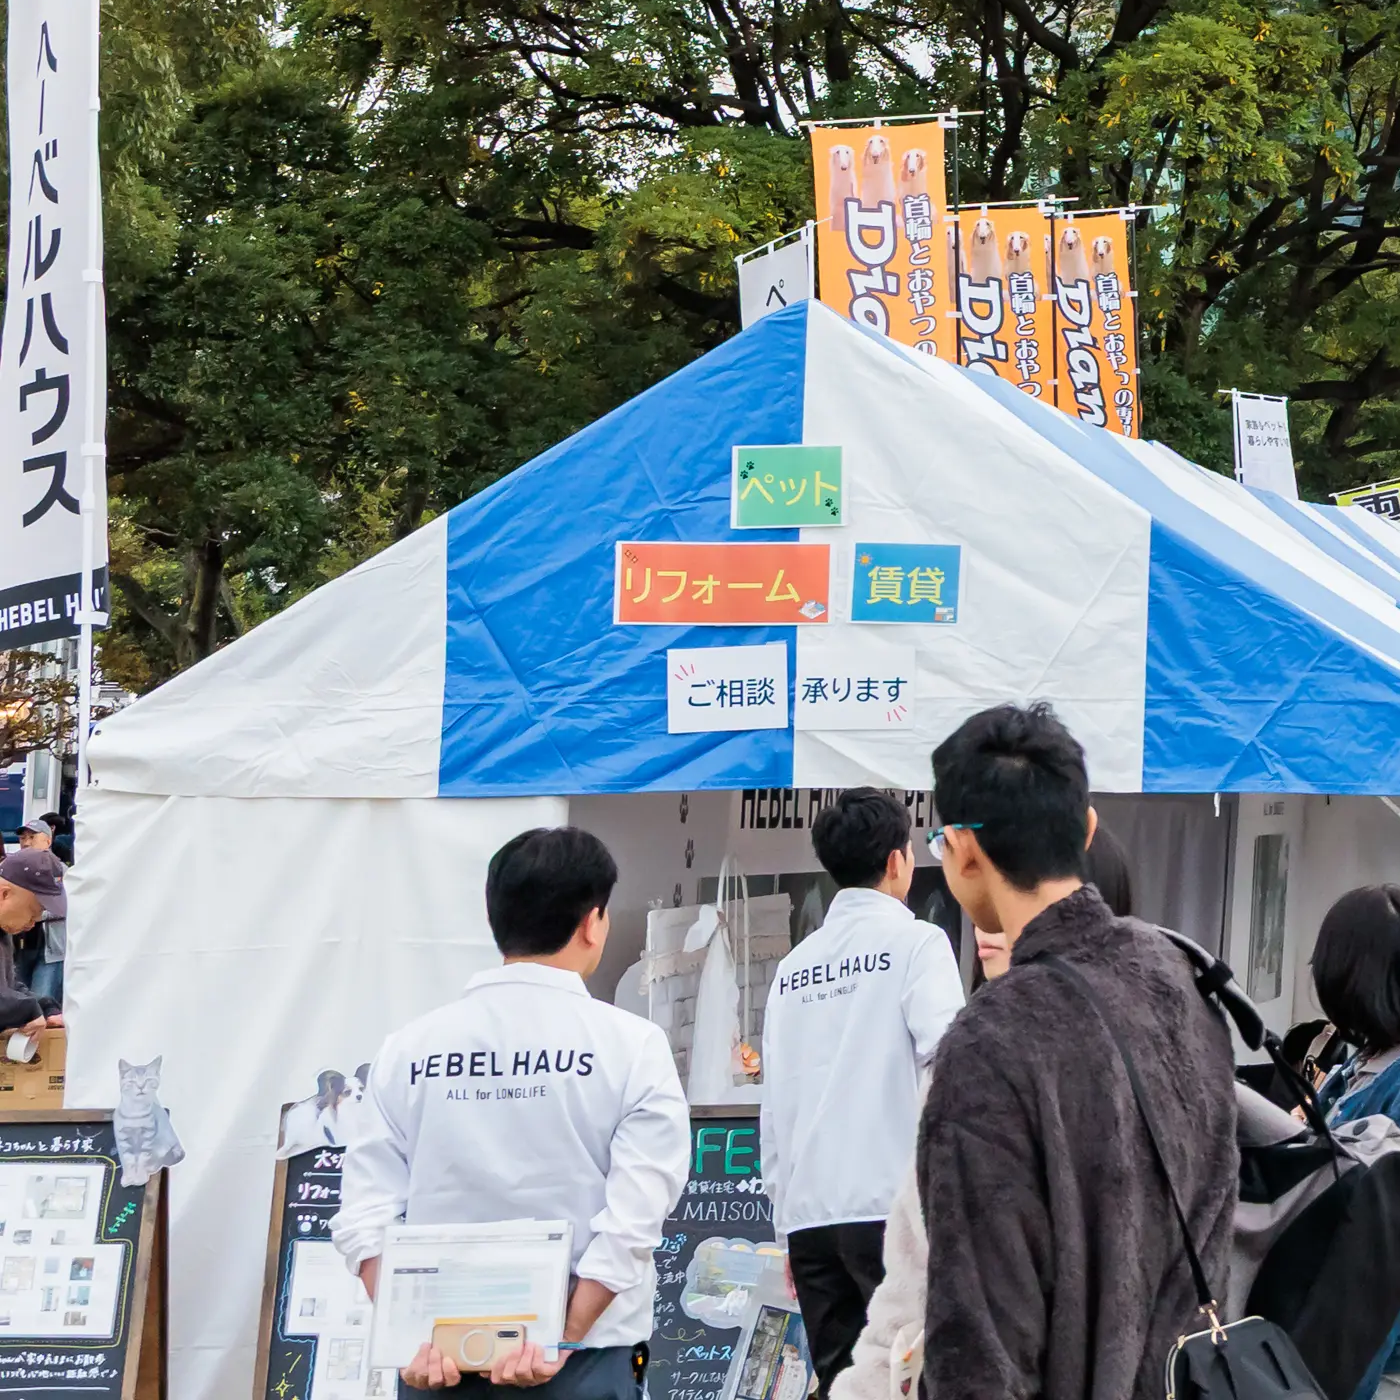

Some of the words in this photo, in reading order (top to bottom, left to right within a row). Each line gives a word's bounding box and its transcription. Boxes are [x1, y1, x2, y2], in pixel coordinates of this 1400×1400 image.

[18, 20, 81, 528] ヘーベルハウス
[740, 471, 839, 506] ペット
[625, 567, 801, 605] リフォーム
[866, 565, 946, 606] 賃貸
[687, 677, 776, 709] ご相談
[801, 677, 908, 704] 承ります
[779, 963, 836, 995] HEBEL
[839, 952, 891, 980] HAUS
[410, 1051, 504, 1085] HEBEL
[512, 1049, 594, 1077] HAUS
[446, 1089, 469, 1101] ALL
[476, 1088, 492, 1100] for
[496, 1085, 546, 1100] LONGLIFE
[298, 1182, 342, 1200] リフォー
[683, 1201, 774, 1222] MAISON
